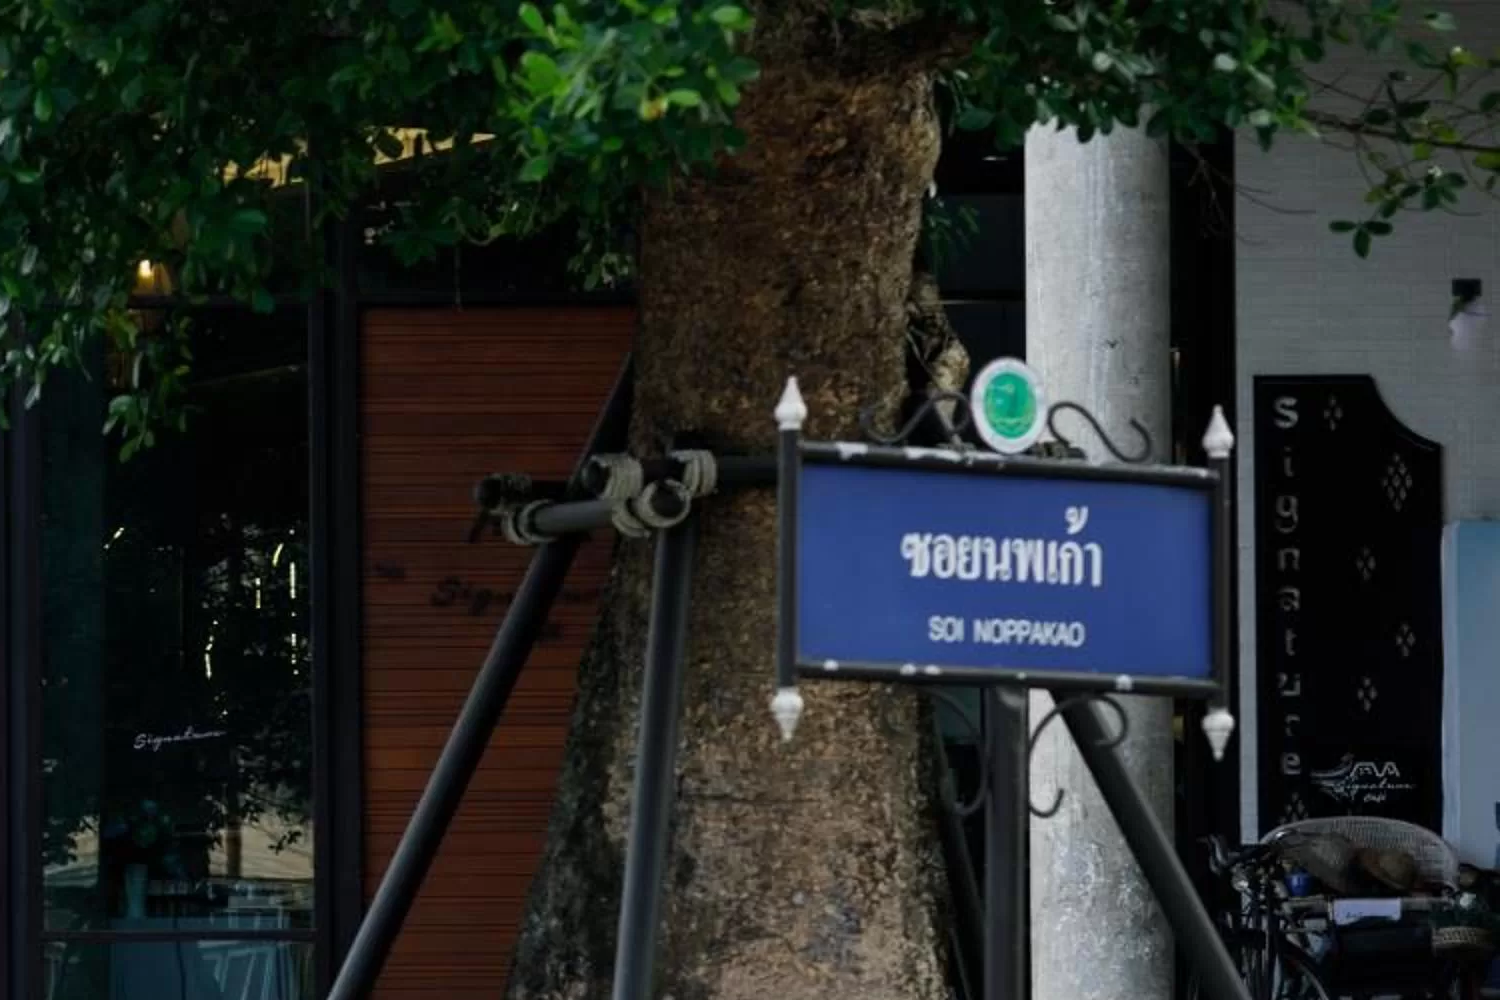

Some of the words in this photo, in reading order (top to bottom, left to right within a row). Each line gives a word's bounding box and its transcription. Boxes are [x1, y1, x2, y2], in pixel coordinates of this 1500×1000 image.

[901, 505, 1103, 588] ซอยนพเก้า
[927, 614, 965, 643] SOI
[972, 617, 1086, 648] NOPPAKAO
